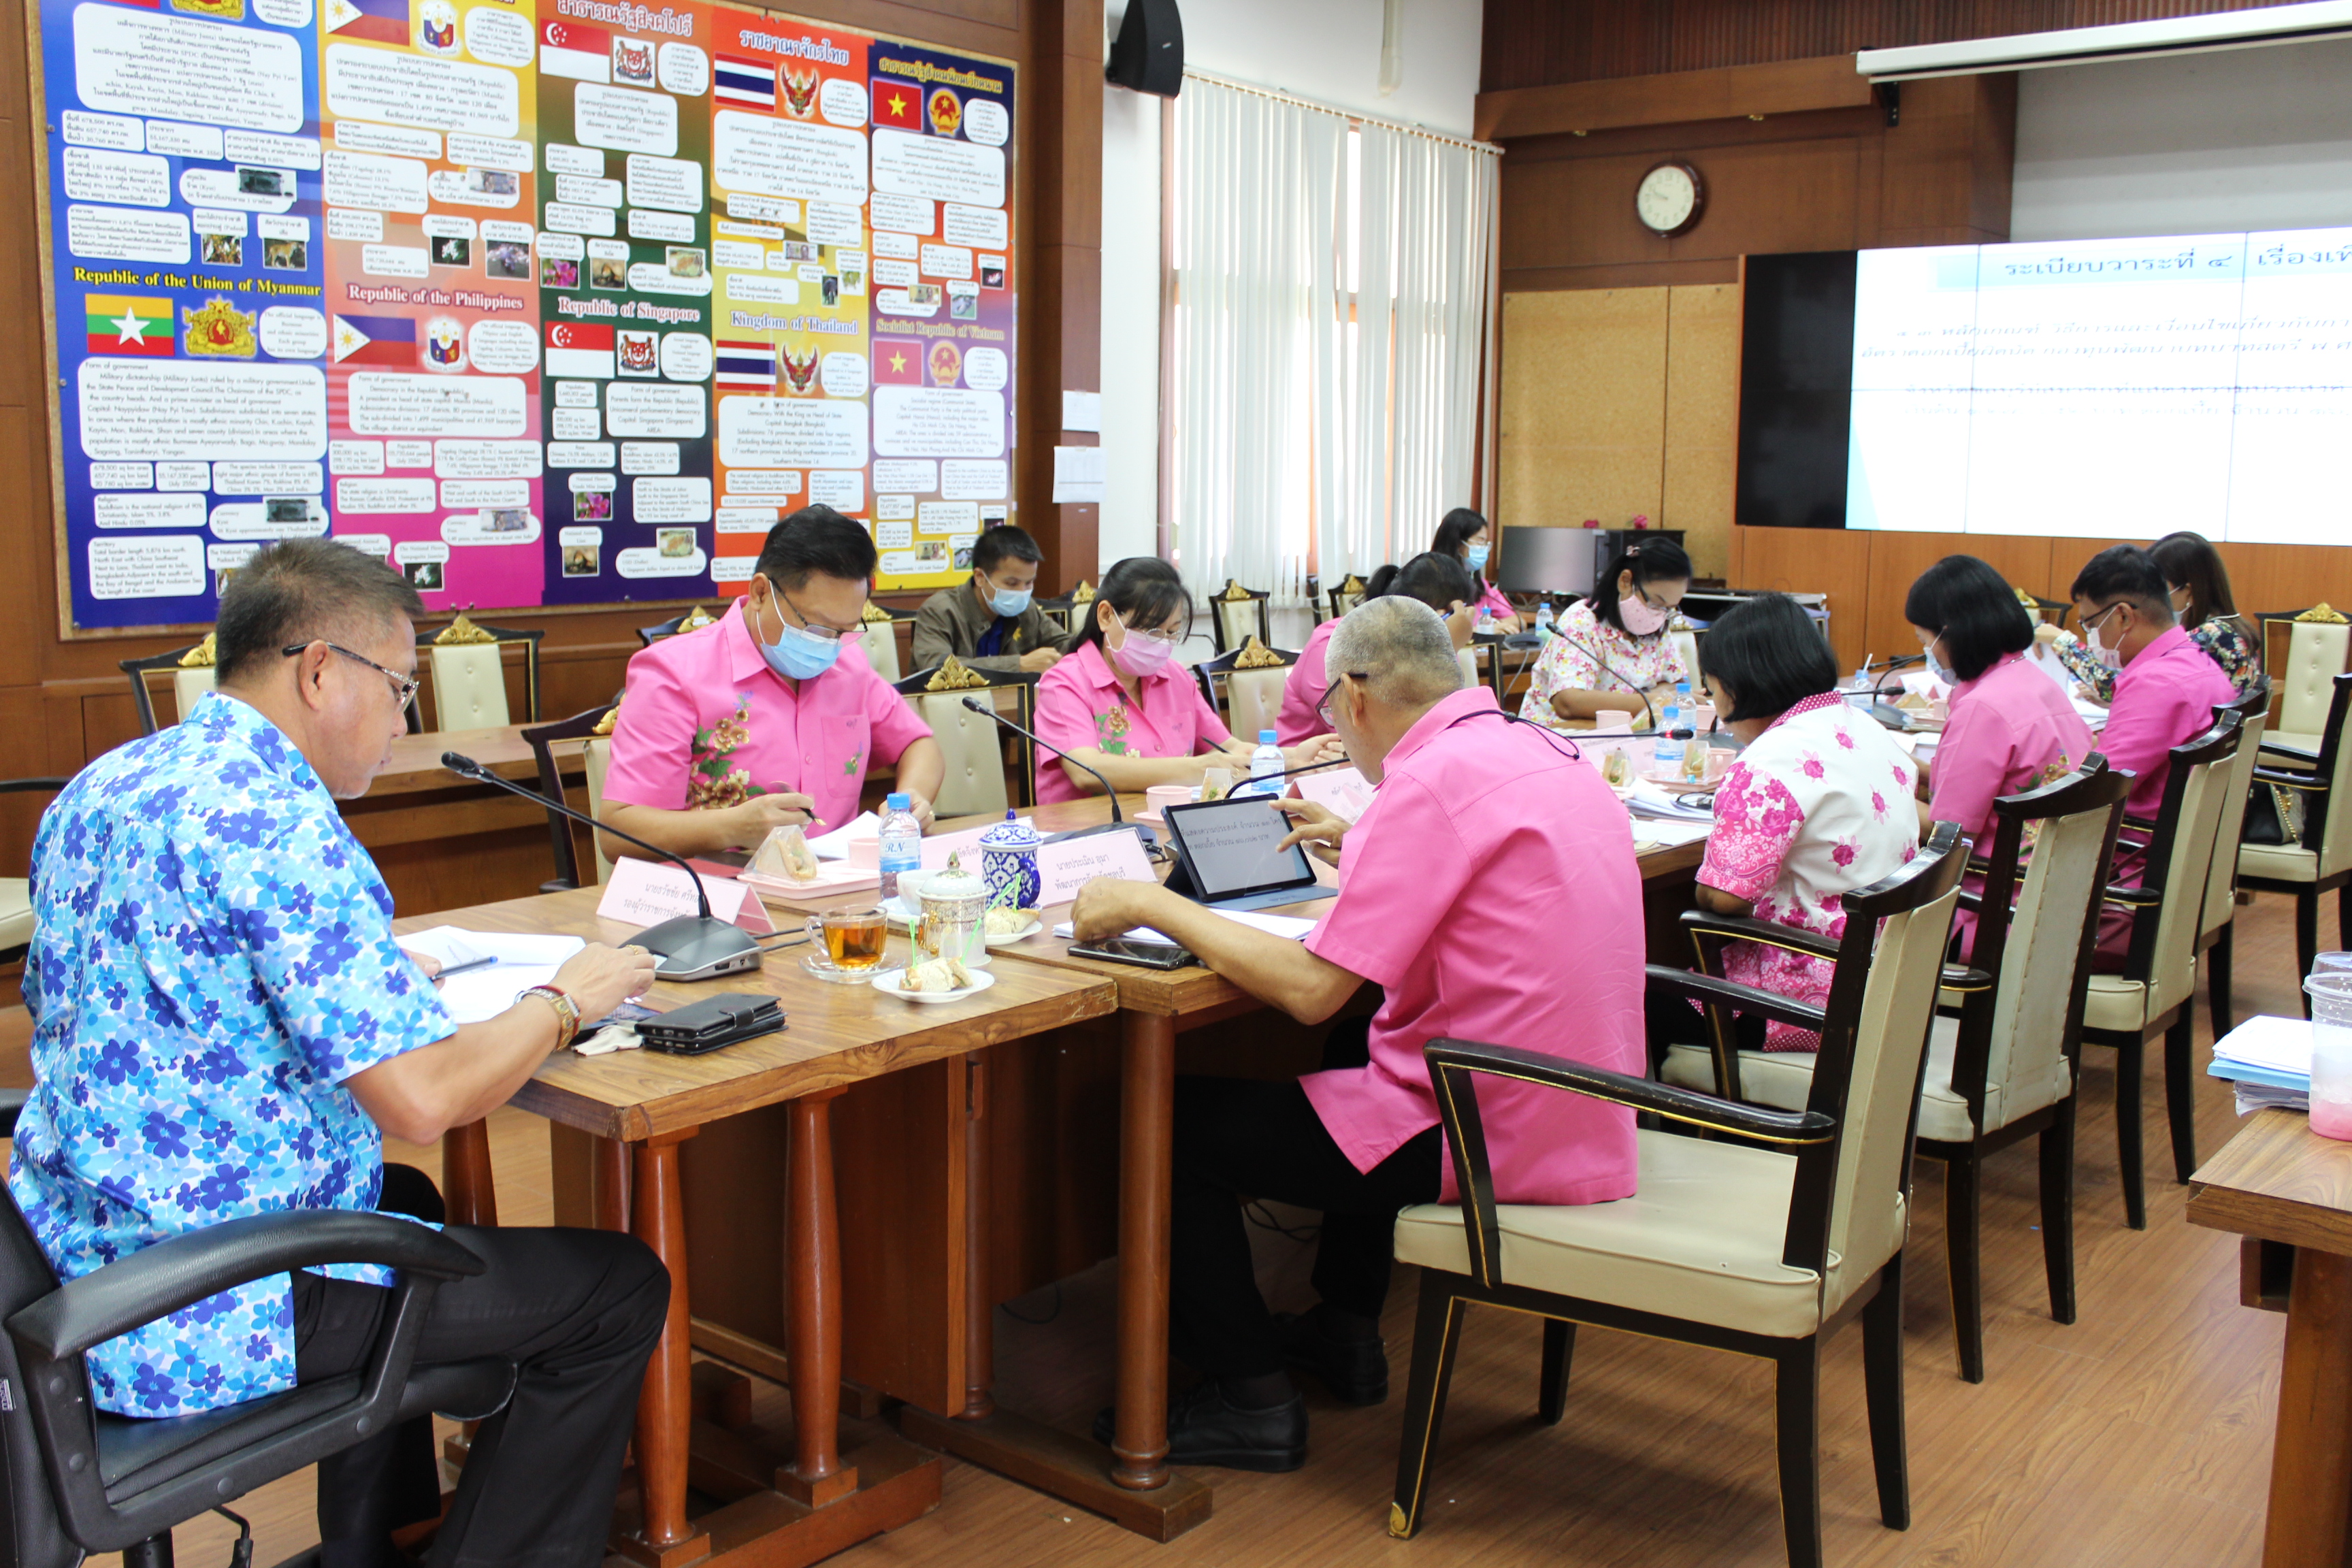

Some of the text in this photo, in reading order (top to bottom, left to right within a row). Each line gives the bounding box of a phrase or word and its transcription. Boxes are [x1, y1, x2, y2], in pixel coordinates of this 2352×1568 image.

[557, 0, 693, 37] สาธารณรัฐสิงคโปร์
[739, 29, 849, 65] ราชอาณาจักรไทย
[2005, 248, 2195, 276] ระเบียบวาระที่
[2208, 255, 2233, 267] ๔
[74, 266, 321, 297] Republic of the Union of Myanmar
[348, 283, 523, 311] Republic of the Philippines
[558, 296, 700, 324] Republic of Singapore
[730, 311, 858, 335] Kingdom of Thailand
[876, 318, 1004, 340] Socialist Republic of Vietnam
[1056, 855, 1094, 871] นายประเมิน
[645, 883, 681, 899] นายธวัชชัย
